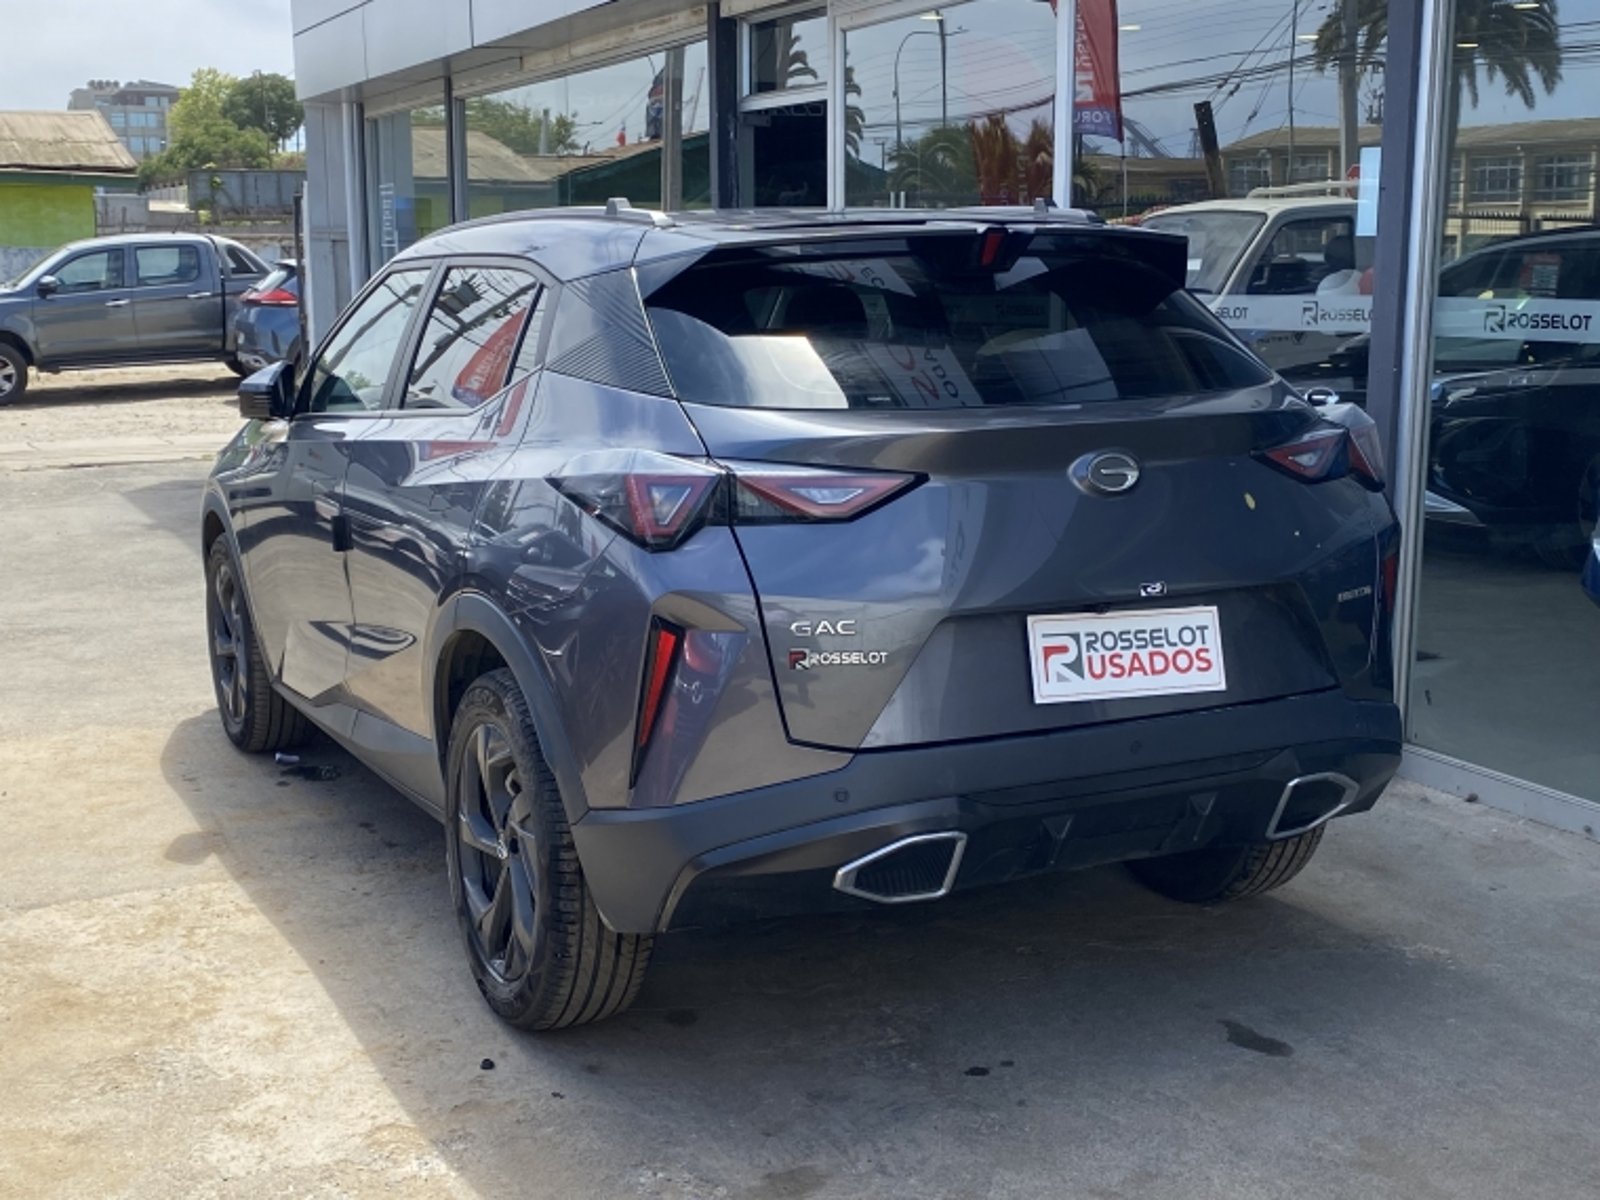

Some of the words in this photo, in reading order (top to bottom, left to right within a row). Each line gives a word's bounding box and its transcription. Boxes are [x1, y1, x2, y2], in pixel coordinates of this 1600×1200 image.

[1507, 312, 1593, 331] ROSSELOT
[789, 619, 857, 637] GAC
[1084, 625, 1210, 654] ROSSELOT
[810, 651, 889, 667] ROSSELOT
[1086, 647, 1213, 681] USADOS
